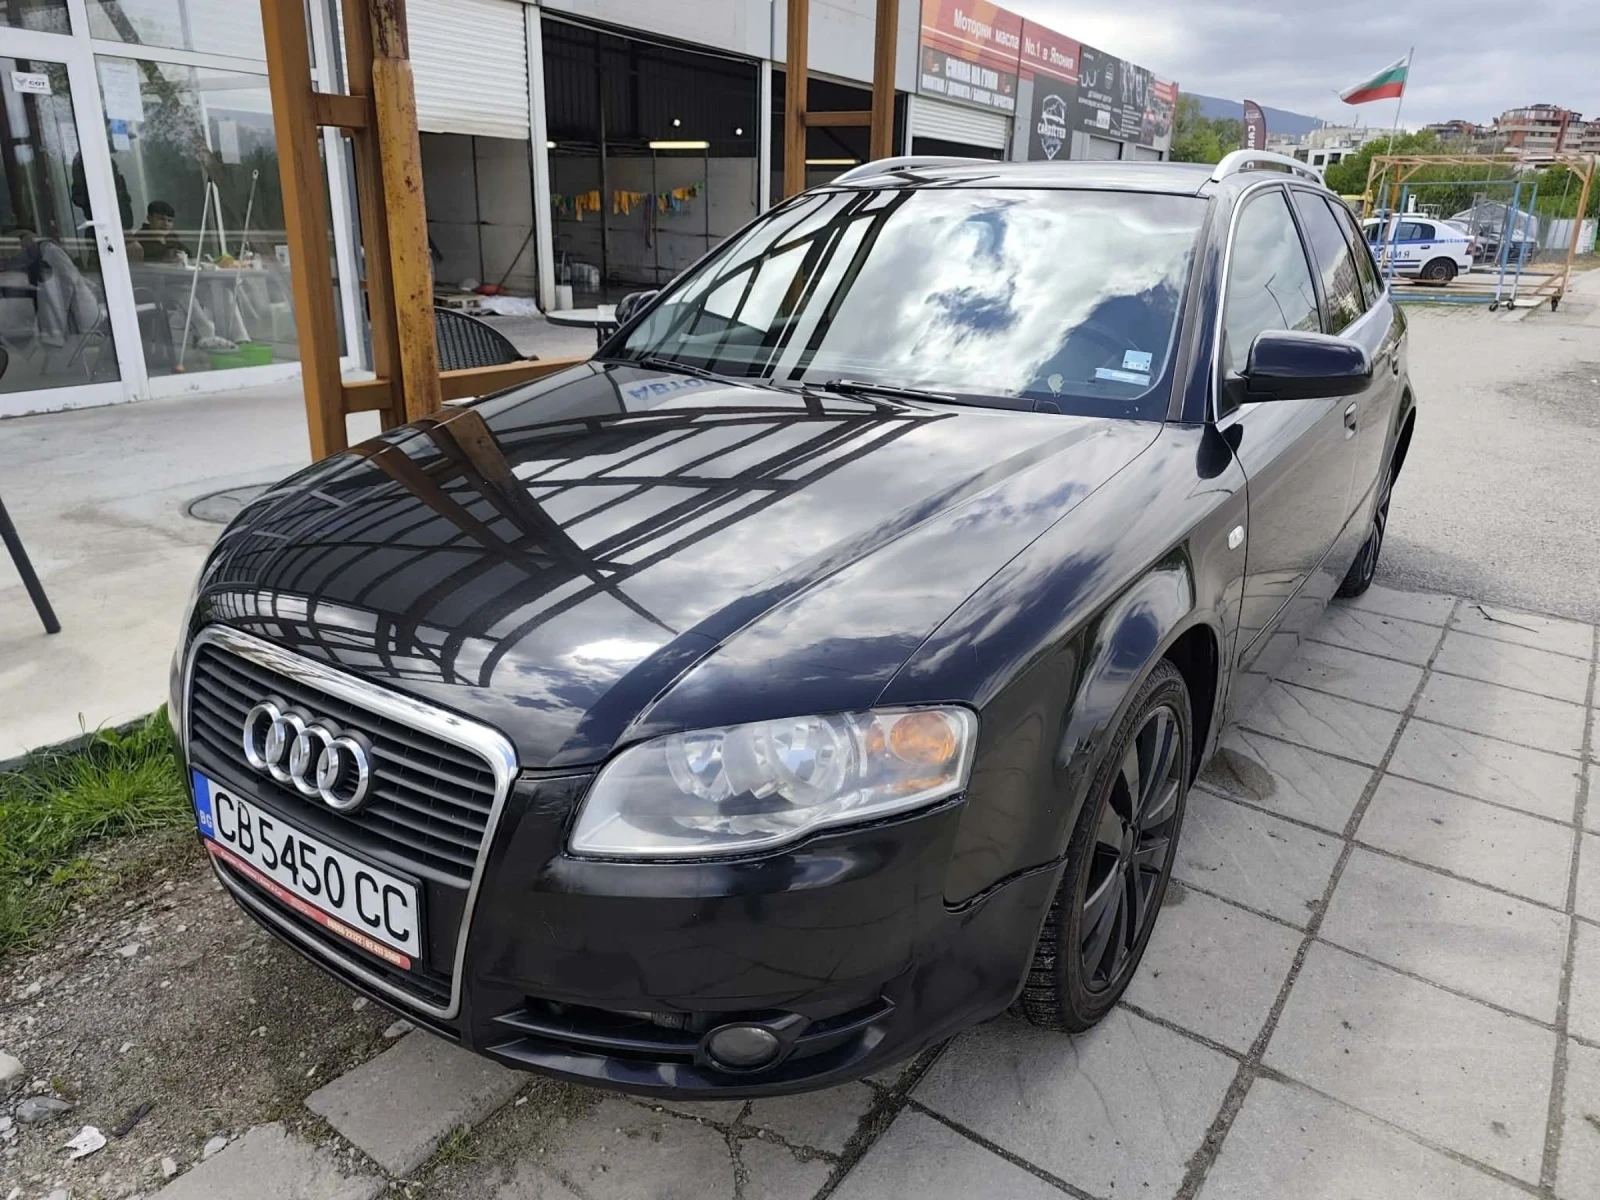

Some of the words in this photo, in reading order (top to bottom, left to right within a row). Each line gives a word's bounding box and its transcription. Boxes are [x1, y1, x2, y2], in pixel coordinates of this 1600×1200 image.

[953, 8, 992, 40] Моторни
[995, 27, 1020, 50] масла
[1024, 37, 1042, 58] No.1
[1049, 46, 1074, 69] Япония
[199, 809, 213, 829] BG
[258, 816, 345, 909] 5450
